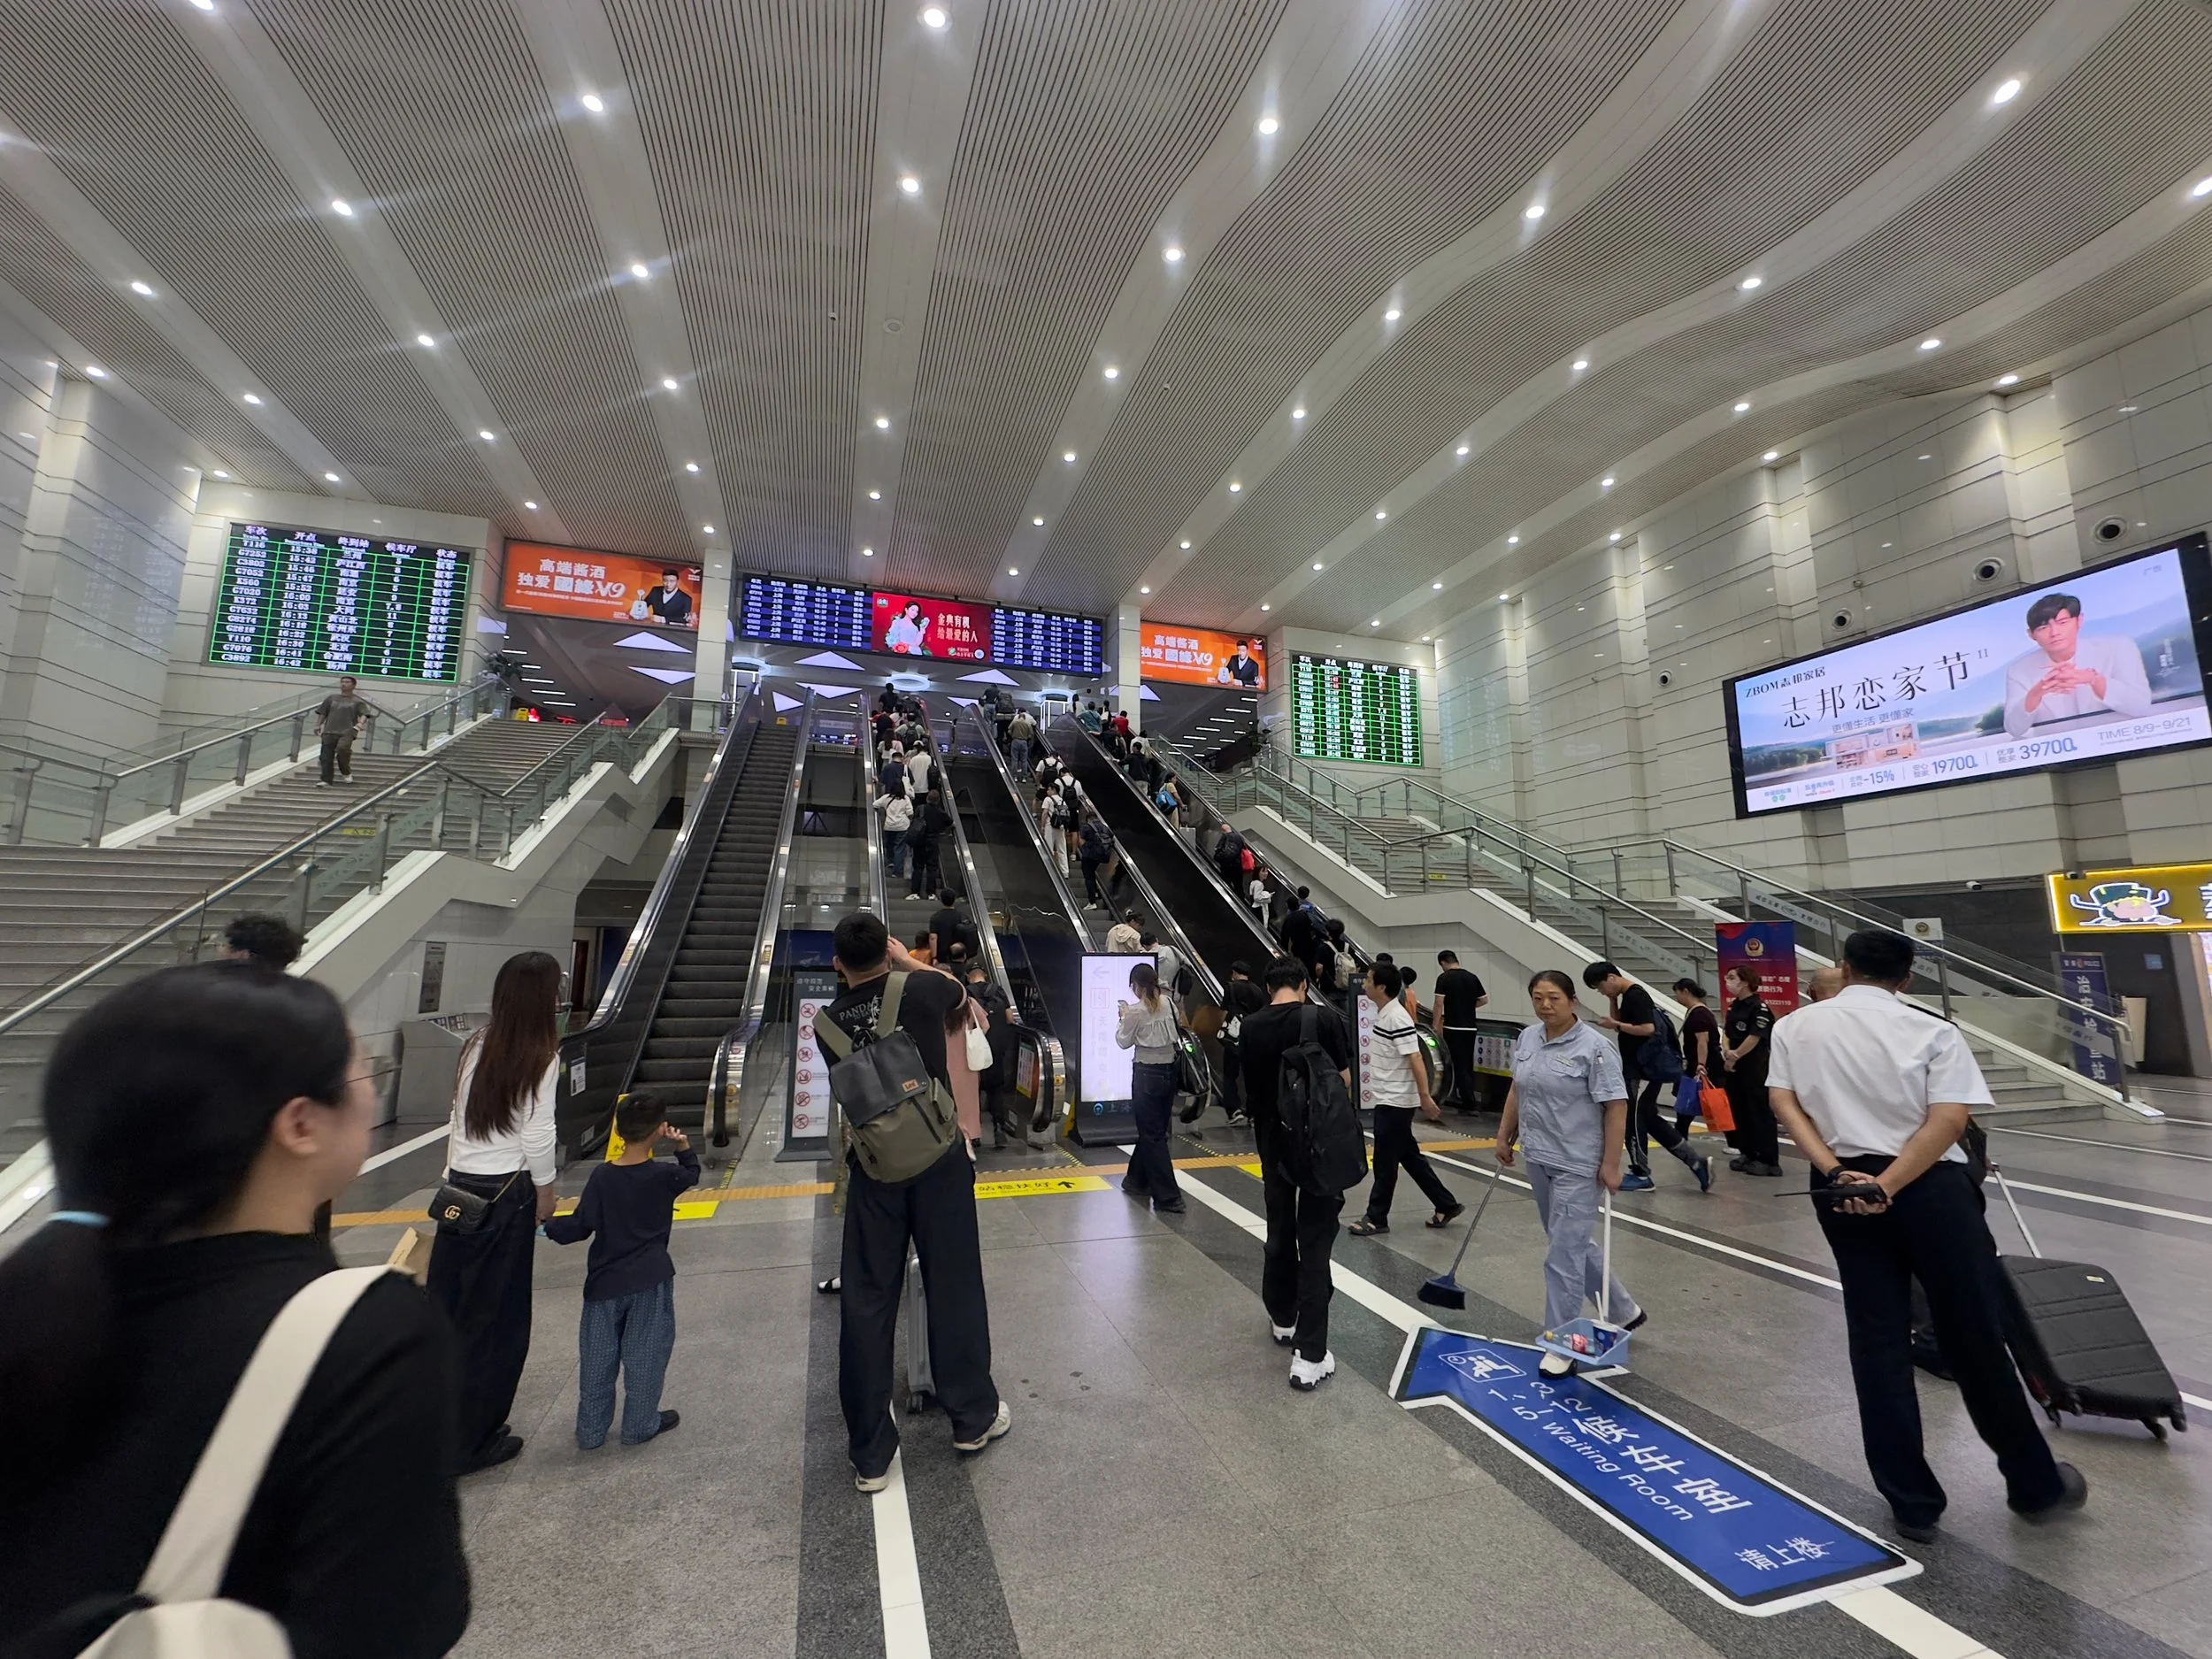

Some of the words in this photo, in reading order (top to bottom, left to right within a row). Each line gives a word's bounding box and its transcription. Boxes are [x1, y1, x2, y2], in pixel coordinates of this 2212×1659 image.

[244, 525, 268, 536] 车次
[295, 531, 317, 542] 开点
[337, 536, 370, 549] 终到站
[385, 541, 418, 554] 候车厅
[539, 558, 606, 580] 高端酱酒
[937, 612, 971, 629] 金典有机
[937, 627, 978, 643] 给最爱的人
[1154, 634, 1199, 650] 高端酱酒
[1746, 680, 1781, 698] ZBOM
[1780, 667, 1826, 688] 志邦家居
[1782, 652, 1971, 729] 志邦恋家节
[1832, 717, 1877, 733] 更懂生活
[1878, 708, 1915, 724] 更懂家
[2097, 727, 2132, 741] TIME
[2133, 717, 2192, 735] 8/9-9/21
[1863, 770, 1895, 785] -15%
[1542, 1422, 1620, 1472] Waiting
[1618, 1473, 1693, 1520] Room
[1571, 1416, 1753, 1513] 候车室
[1734, 1537, 1829, 1570] 请上楼
